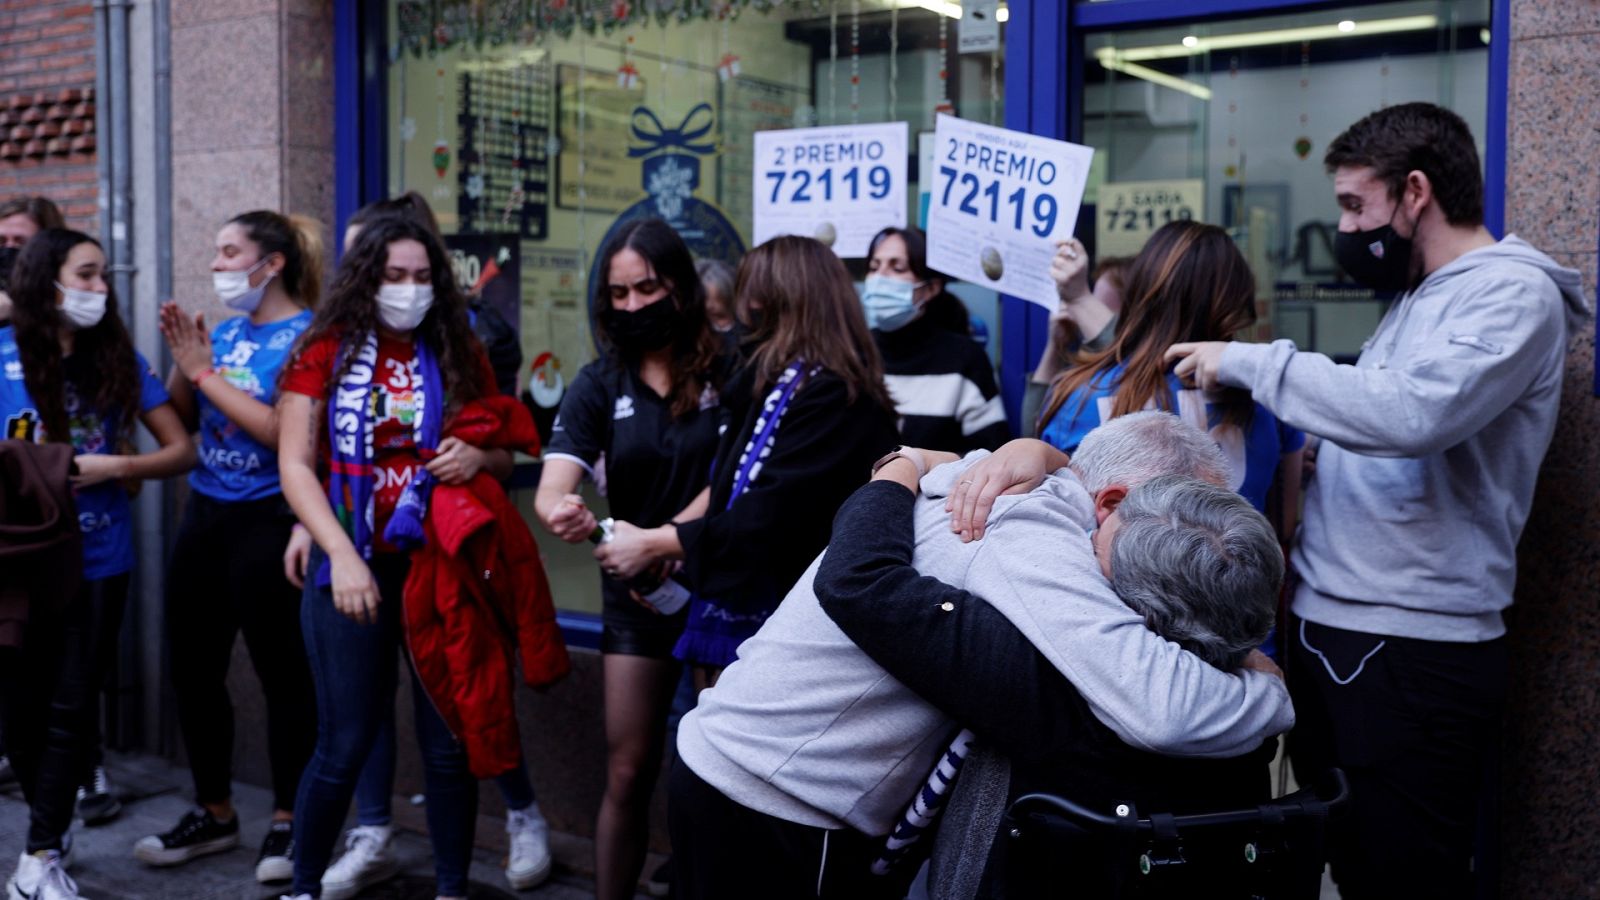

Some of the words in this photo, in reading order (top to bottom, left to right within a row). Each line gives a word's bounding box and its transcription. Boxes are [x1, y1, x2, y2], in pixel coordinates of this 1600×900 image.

[794, 141, 884, 165] PREMIO
[964, 142, 1056, 186] PREMIO
[765, 166, 892, 204] 72119
[939, 165, 1058, 238] 72119
